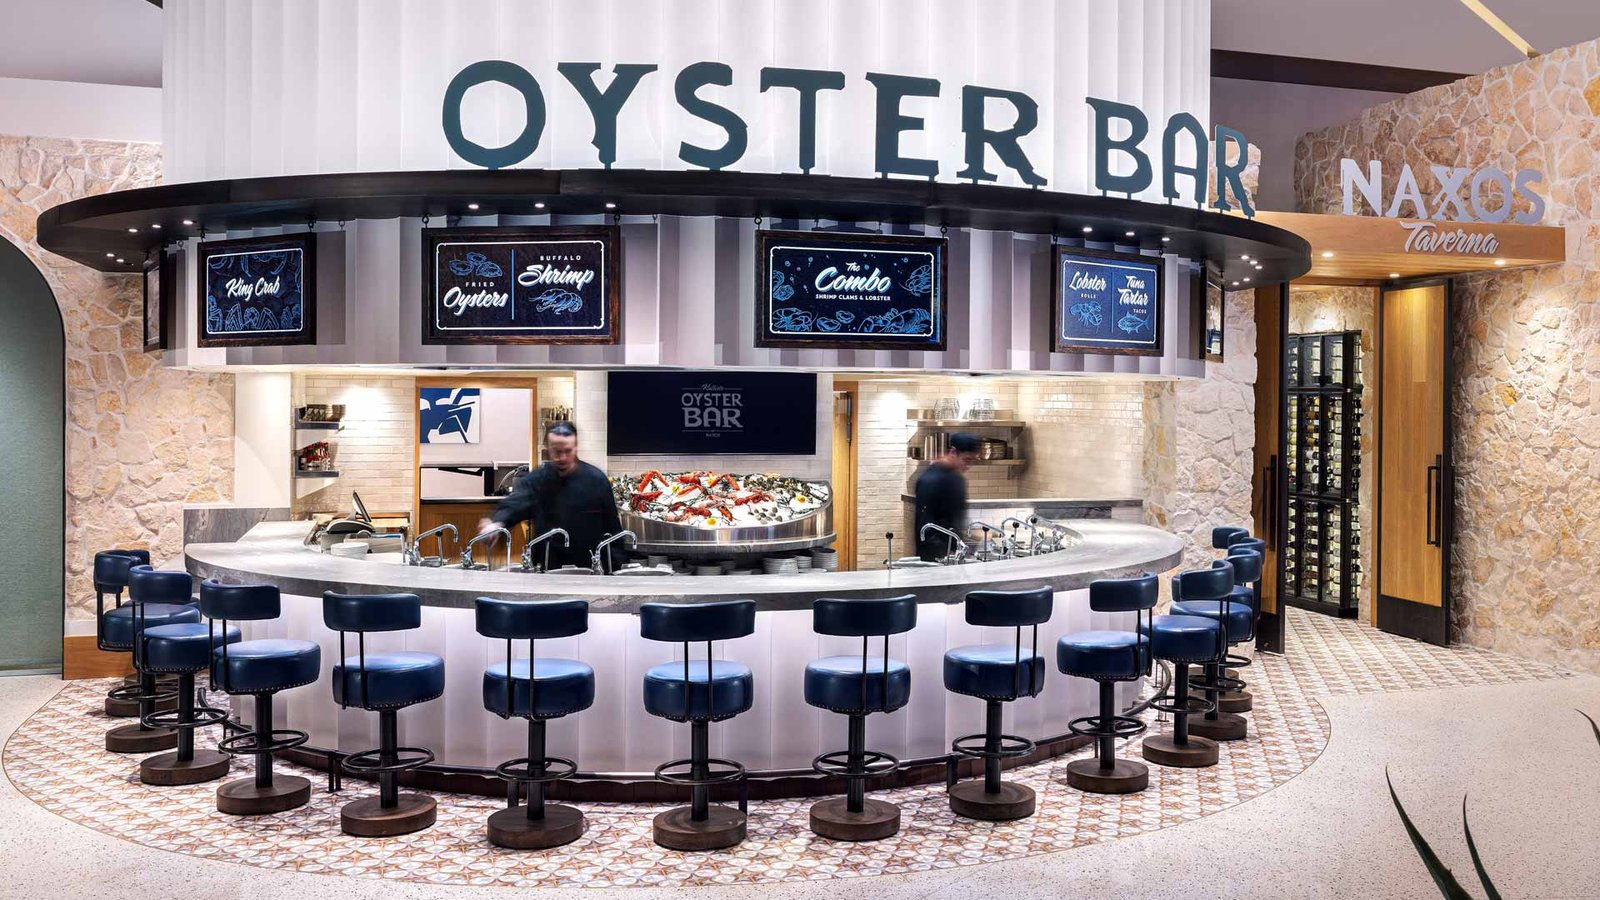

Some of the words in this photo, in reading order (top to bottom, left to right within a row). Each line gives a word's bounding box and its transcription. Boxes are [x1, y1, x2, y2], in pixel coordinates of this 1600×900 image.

[442, 60, 1047, 187] OYSTER
[1086, 97, 1255, 218] BAR
[1341, 158, 1546, 225] NAXOS
[1400, 220, 1499, 255] Taverna
[518, 264, 595, 291] Shrimp
[815, 266, 892, 293] Combo
[845, 262, 861, 272] The
[225, 277, 254, 301] King
[255, 275, 281, 296] Crab
[1069, 271, 1107, 291] Lobster
[1125, 274, 1146, 289] Tuna
[443, 286, 509, 316] Oysters
[1118, 287, 1149, 306] Tartar
[681, 392, 744, 406] OYSTER
[681, 407, 744, 428] BAR
